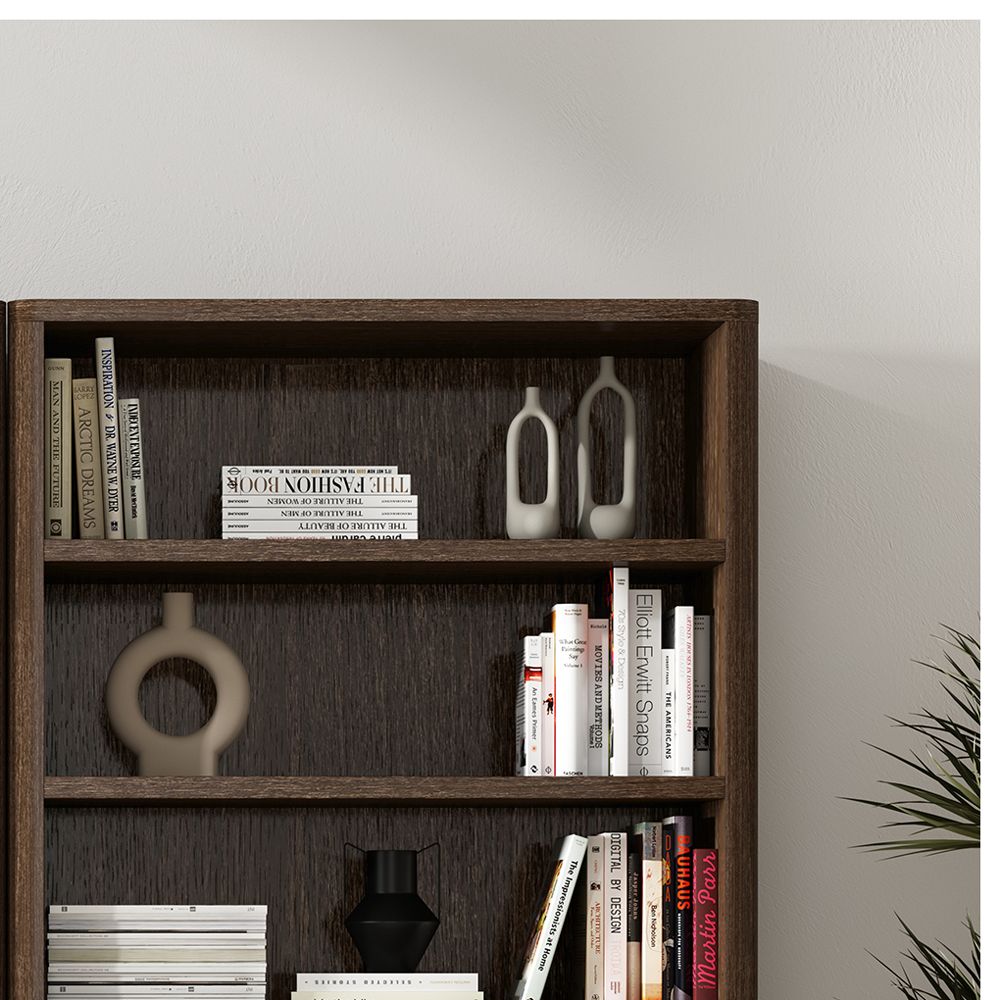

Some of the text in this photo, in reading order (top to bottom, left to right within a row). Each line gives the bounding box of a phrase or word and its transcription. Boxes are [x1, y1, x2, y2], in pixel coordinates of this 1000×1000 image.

[101, 349, 114, 409] INSPIRATION
[52, 381, 60, 508] MAN AND THE FUTURE
[78, 407, 96, 529] ARCTIC DREAMS
[106, 442, 117, 478] WAYNE
[108, 490, 119, 513] DYER
[228, 476, 409, 493] THE FASHION BOOK
[297, 522, 407, 530] THE ALLURE OF BEAUTY
[531, 687, 538, 696] An
[594, 645, 603, 749] MOVIES AND METHODS
[633, 594, 653, 757] Elliott Erwitt Snaps
[610, 833, 621, 934] DIGITAL BY DESIGN
[677, 834, 691, 910] BAUHAUS
[538, 860, 579, 972] The Impressionists at Home
[650, 904, 658, 948] Ben Nicholson
[696, 851, 716, 989] Martin Parr
